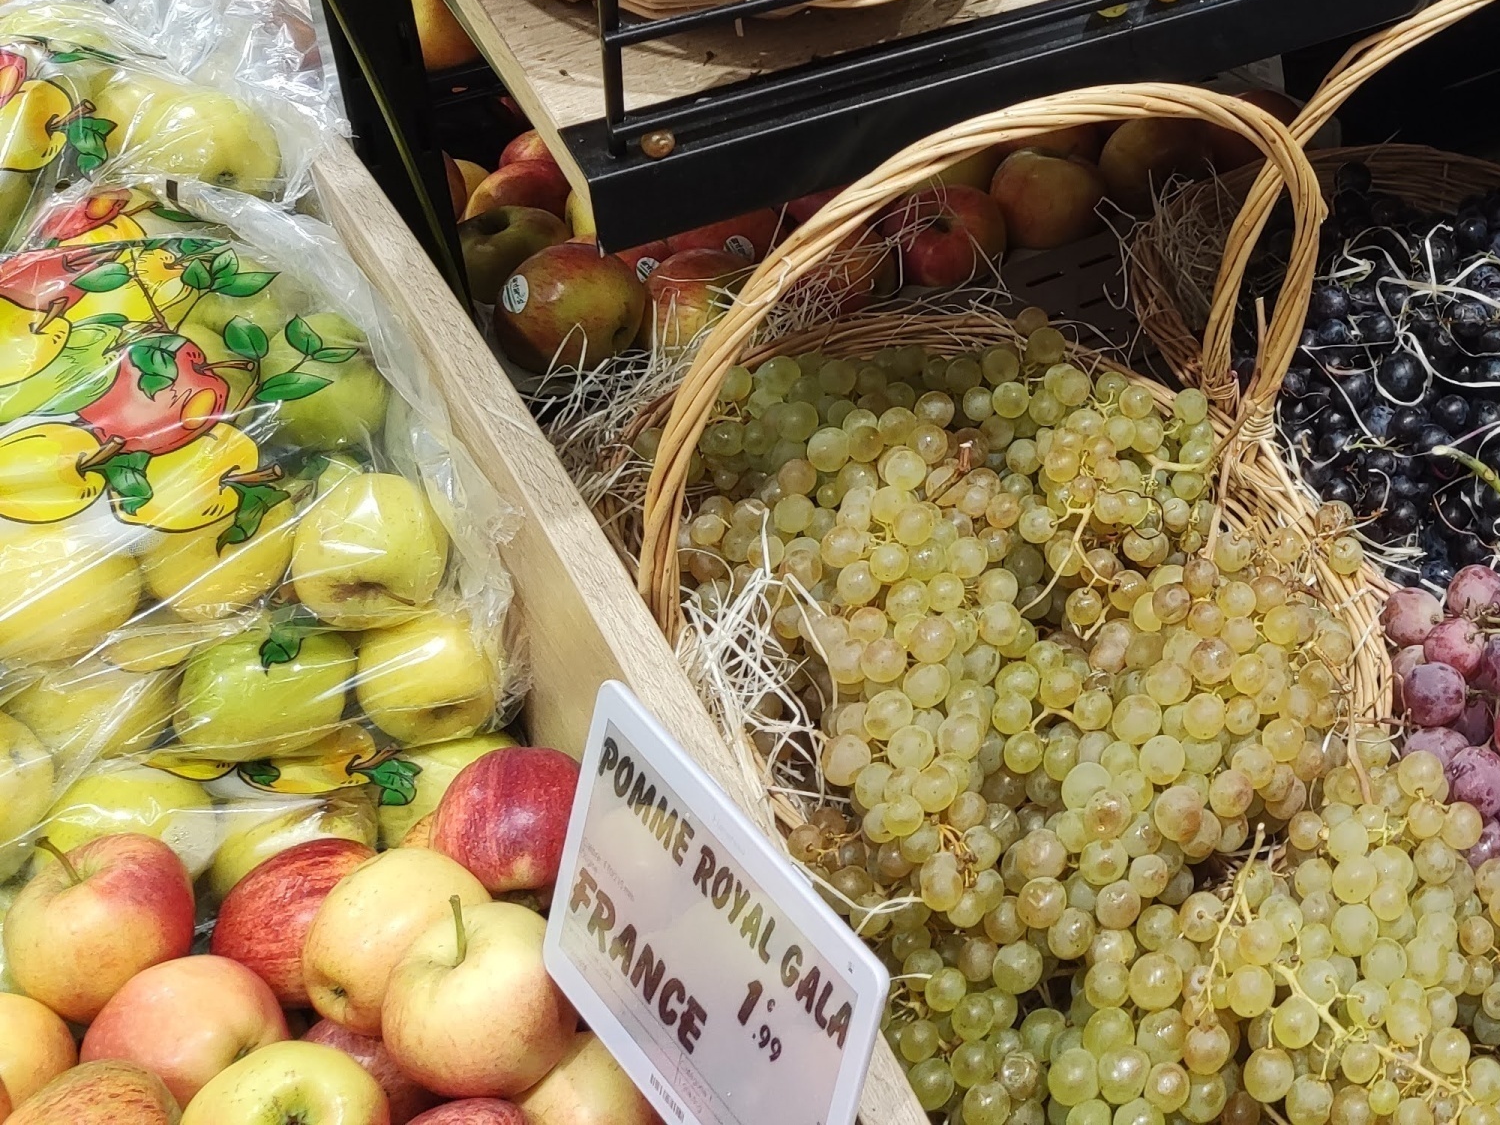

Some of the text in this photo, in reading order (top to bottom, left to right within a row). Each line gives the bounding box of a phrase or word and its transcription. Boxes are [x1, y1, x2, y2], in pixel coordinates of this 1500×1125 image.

[569, 866, 708, 1055] FRANCE
[599, 736, 695, 867] POMME
[692, 844, 776, 964] ROYAL
[780, 944, 853, 1051] GALA
